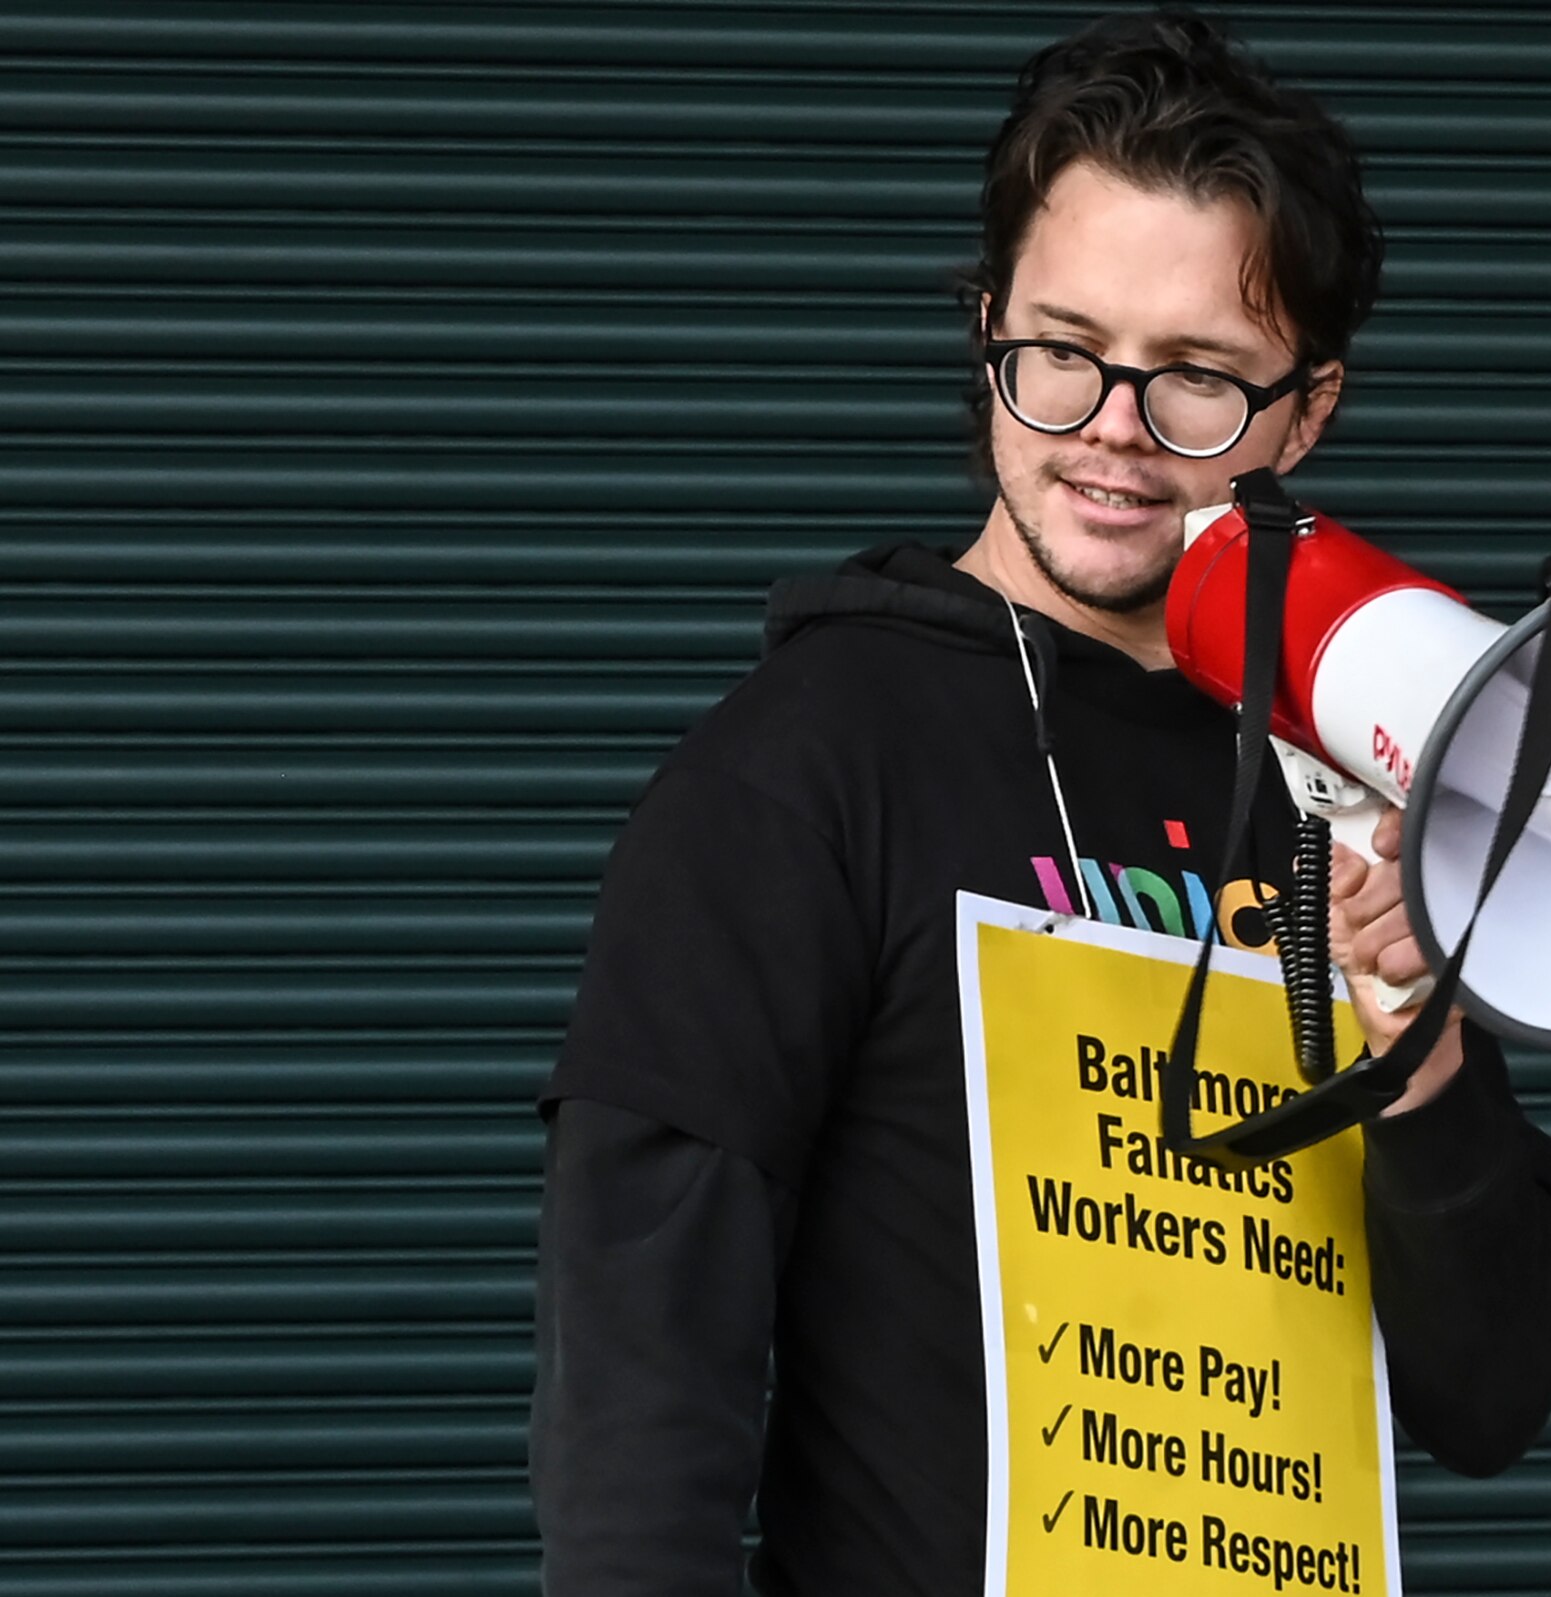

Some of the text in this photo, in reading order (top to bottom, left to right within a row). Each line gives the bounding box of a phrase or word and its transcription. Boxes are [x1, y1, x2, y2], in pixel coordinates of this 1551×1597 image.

[1027, 1175, 1345, 1296] Workers Need:
[1079, 1323, 1280, 1418] More Pay!
[1082, 1408, 1322, 1503] More Hours!
[1084, 1495, 1360, 1595] More Respect!
